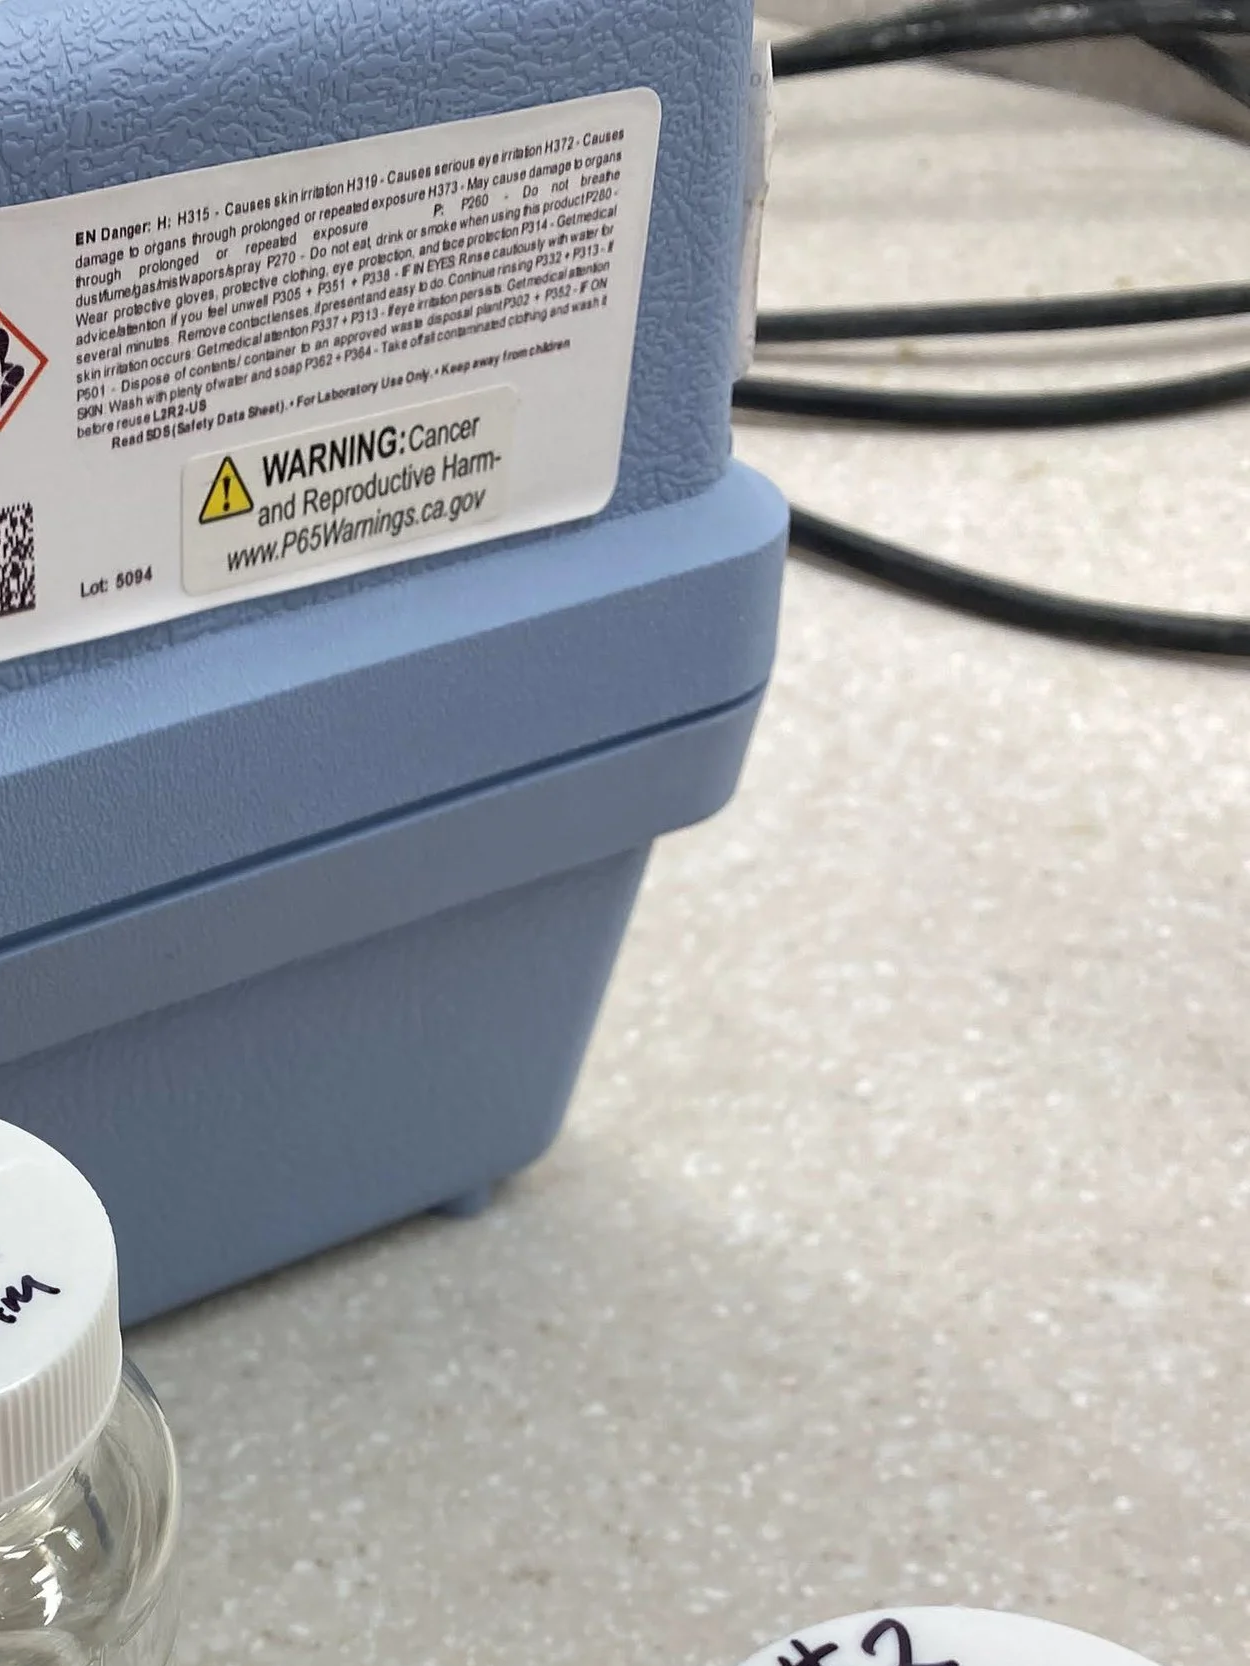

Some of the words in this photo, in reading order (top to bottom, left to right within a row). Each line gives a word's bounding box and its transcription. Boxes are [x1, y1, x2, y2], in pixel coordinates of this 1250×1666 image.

[75, 228, 97, 248] EN
[101, 221, 151, 243] Danger:
[157, 215, 172, 231] H:
[177, 206, 210, 227] H315
[224, 197, 272, 218] Causes
[273, 190, 299, 208] skin
[346, 173, 378, 194] H319
[386, 165, 432, 186] Causes
[434, 157, 476, 177] serious
[544, 135, 575, 155] H372
[582, 128, 625, 148] Causes
[75, 267, 122, 290] through
[138, 250, 200, 279] prolonged
[215, 247, 229, 261] or
[245, 231, 297, 256] repeated
[312, 219, 369, 242] exposure
[460, 192, 489, 212] P260
[522, 184, 539, 200] Do
[550, 177, 569, 194] not
[580, 169, 621, 188] breathe
[257, 491, 296, 528] and
[302, 463, 436, 517] Reproductive
[441, 450, 503, 482] Harm-
[261, 424, 406, 489] WARNING:
[407, 416, 481, 453] Cancer
[226, 488, 487, 573] www.P65Warnings.ca.gov
[80, 577, 109, 599] Lot:
[115, 564, 153, 590] 5094
